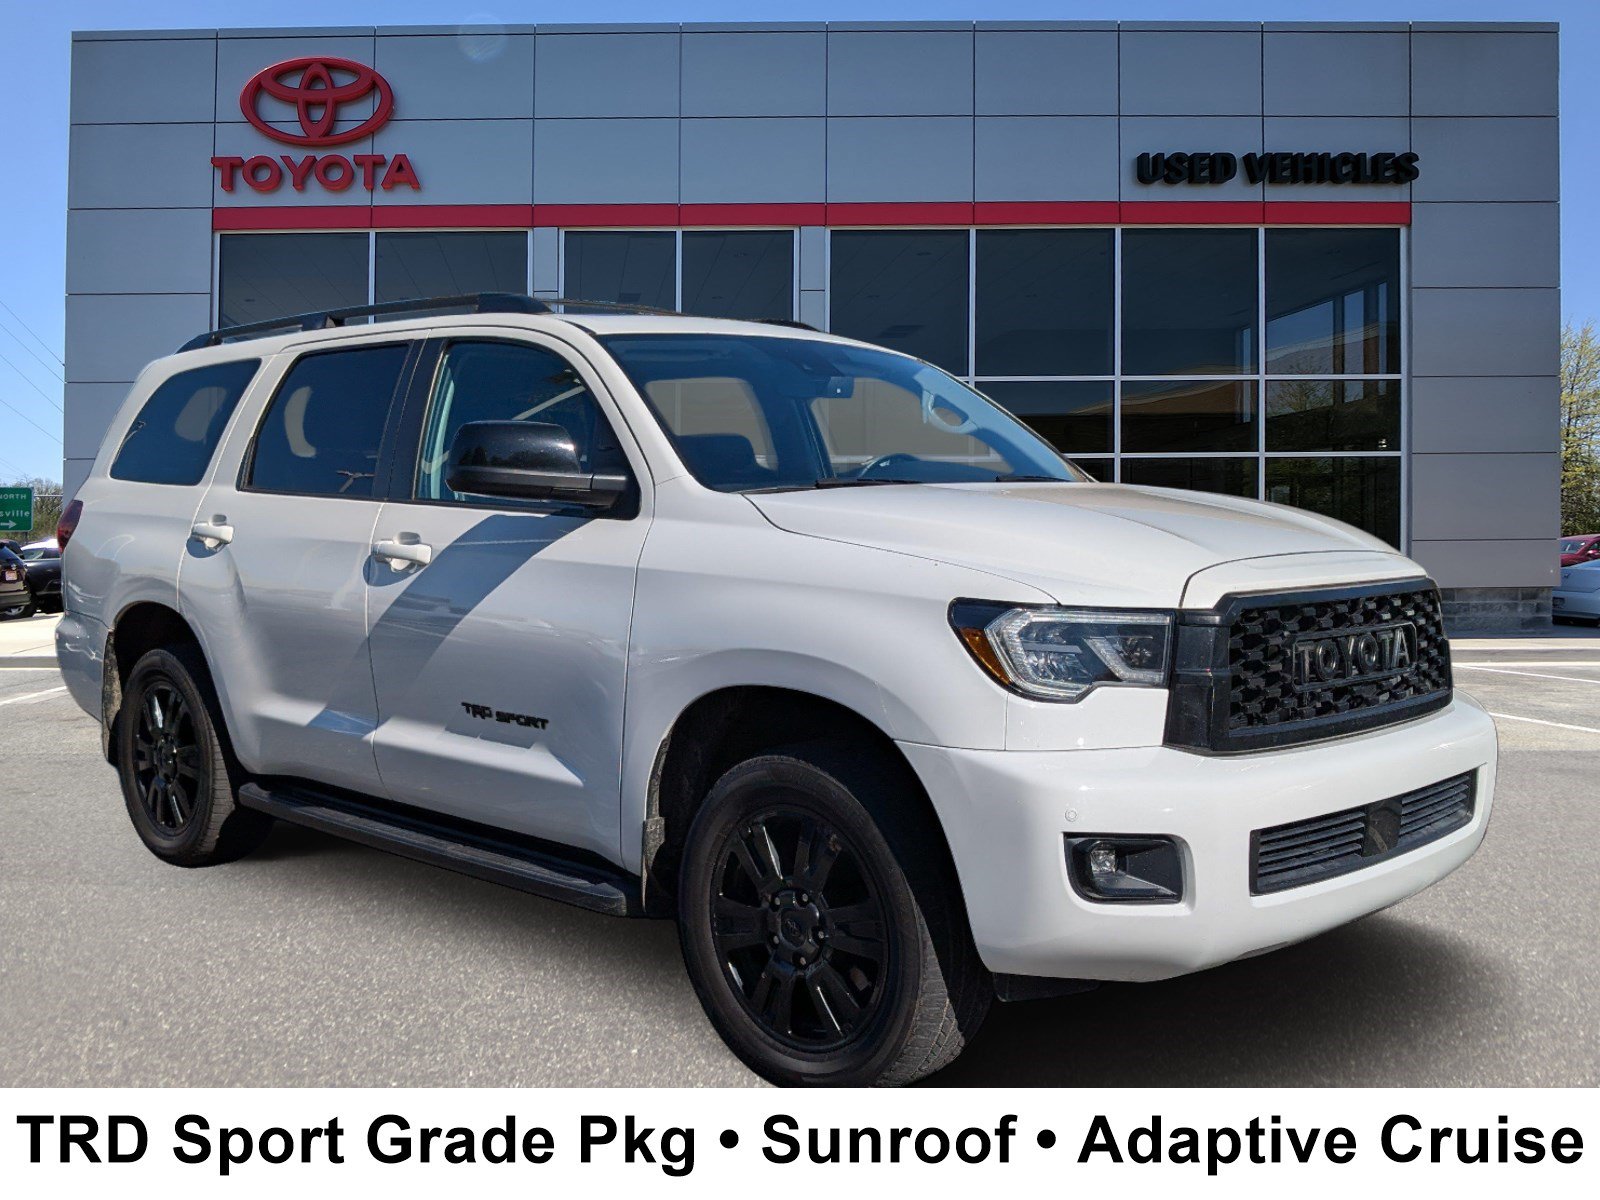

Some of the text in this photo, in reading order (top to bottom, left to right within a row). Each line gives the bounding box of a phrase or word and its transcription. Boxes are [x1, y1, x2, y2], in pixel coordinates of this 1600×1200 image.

[211, 154, 420, 191] TOYOTA
[1136, 152, 1420, 185] USED VEHICLES
[1294, 627, 1410, 685] TOYOTA
[461, 702, 549, 730] TRD SPORT
